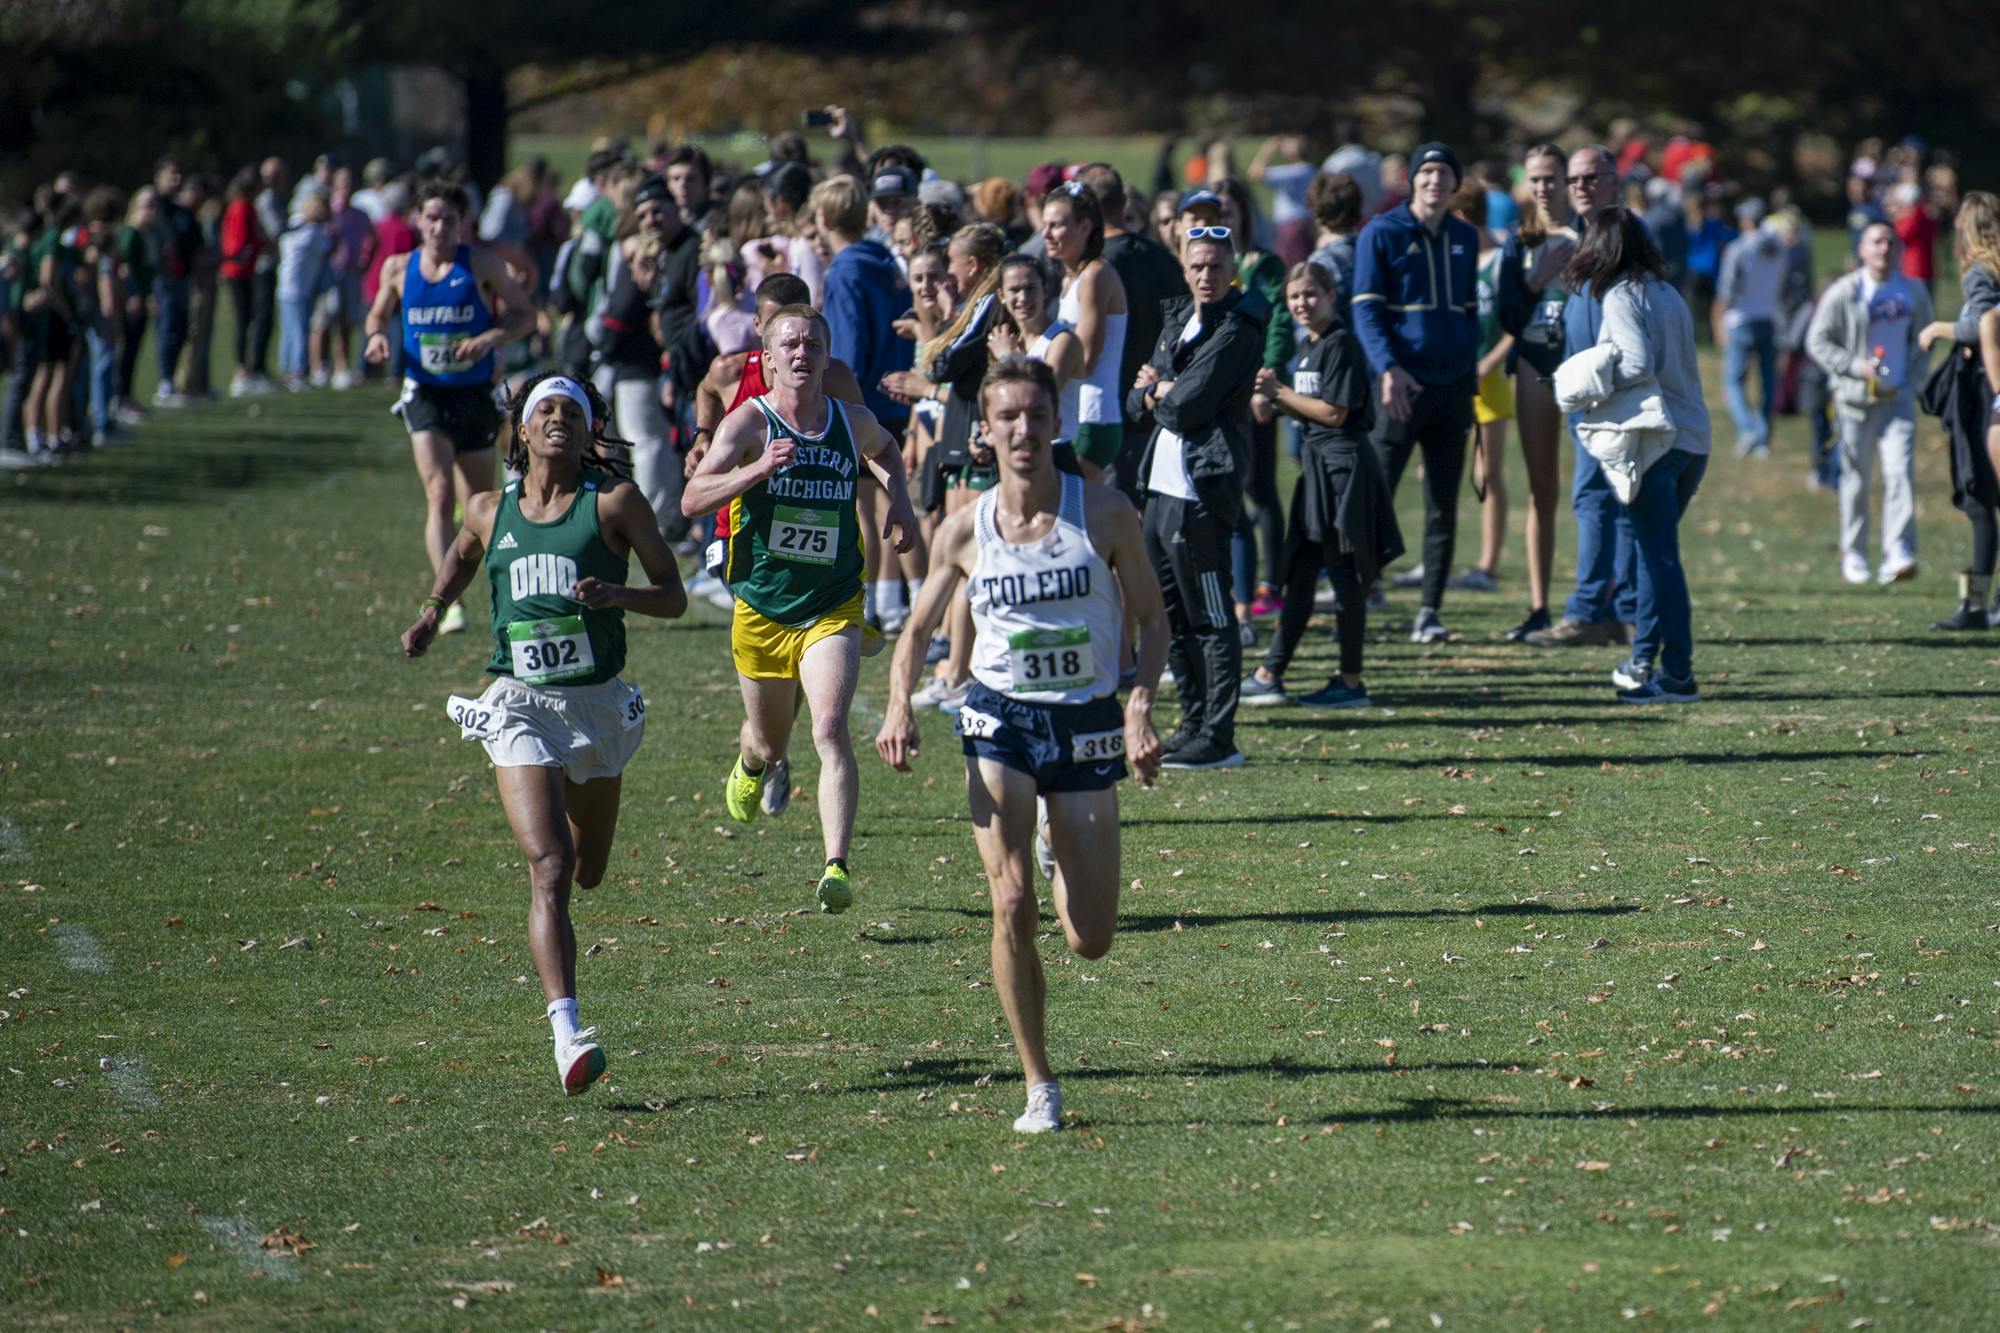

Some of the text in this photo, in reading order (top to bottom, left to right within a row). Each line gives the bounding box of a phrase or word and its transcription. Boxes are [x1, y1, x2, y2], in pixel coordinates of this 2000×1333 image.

[408, 304, 475, 325] BUFFALO
[766, 476, 854, 500] MICHIGAN
[779, 526, 828, 553] 275
[509, 553, 578, 601] OHIO
[982, 565, 1091, 608] TOLEDO
[523, 639, 580, 671] 302
[1023, 651, 1080, 679] 318
[454, 705, 491, 732] 302
[1084, 735, 1123, 758] 318
